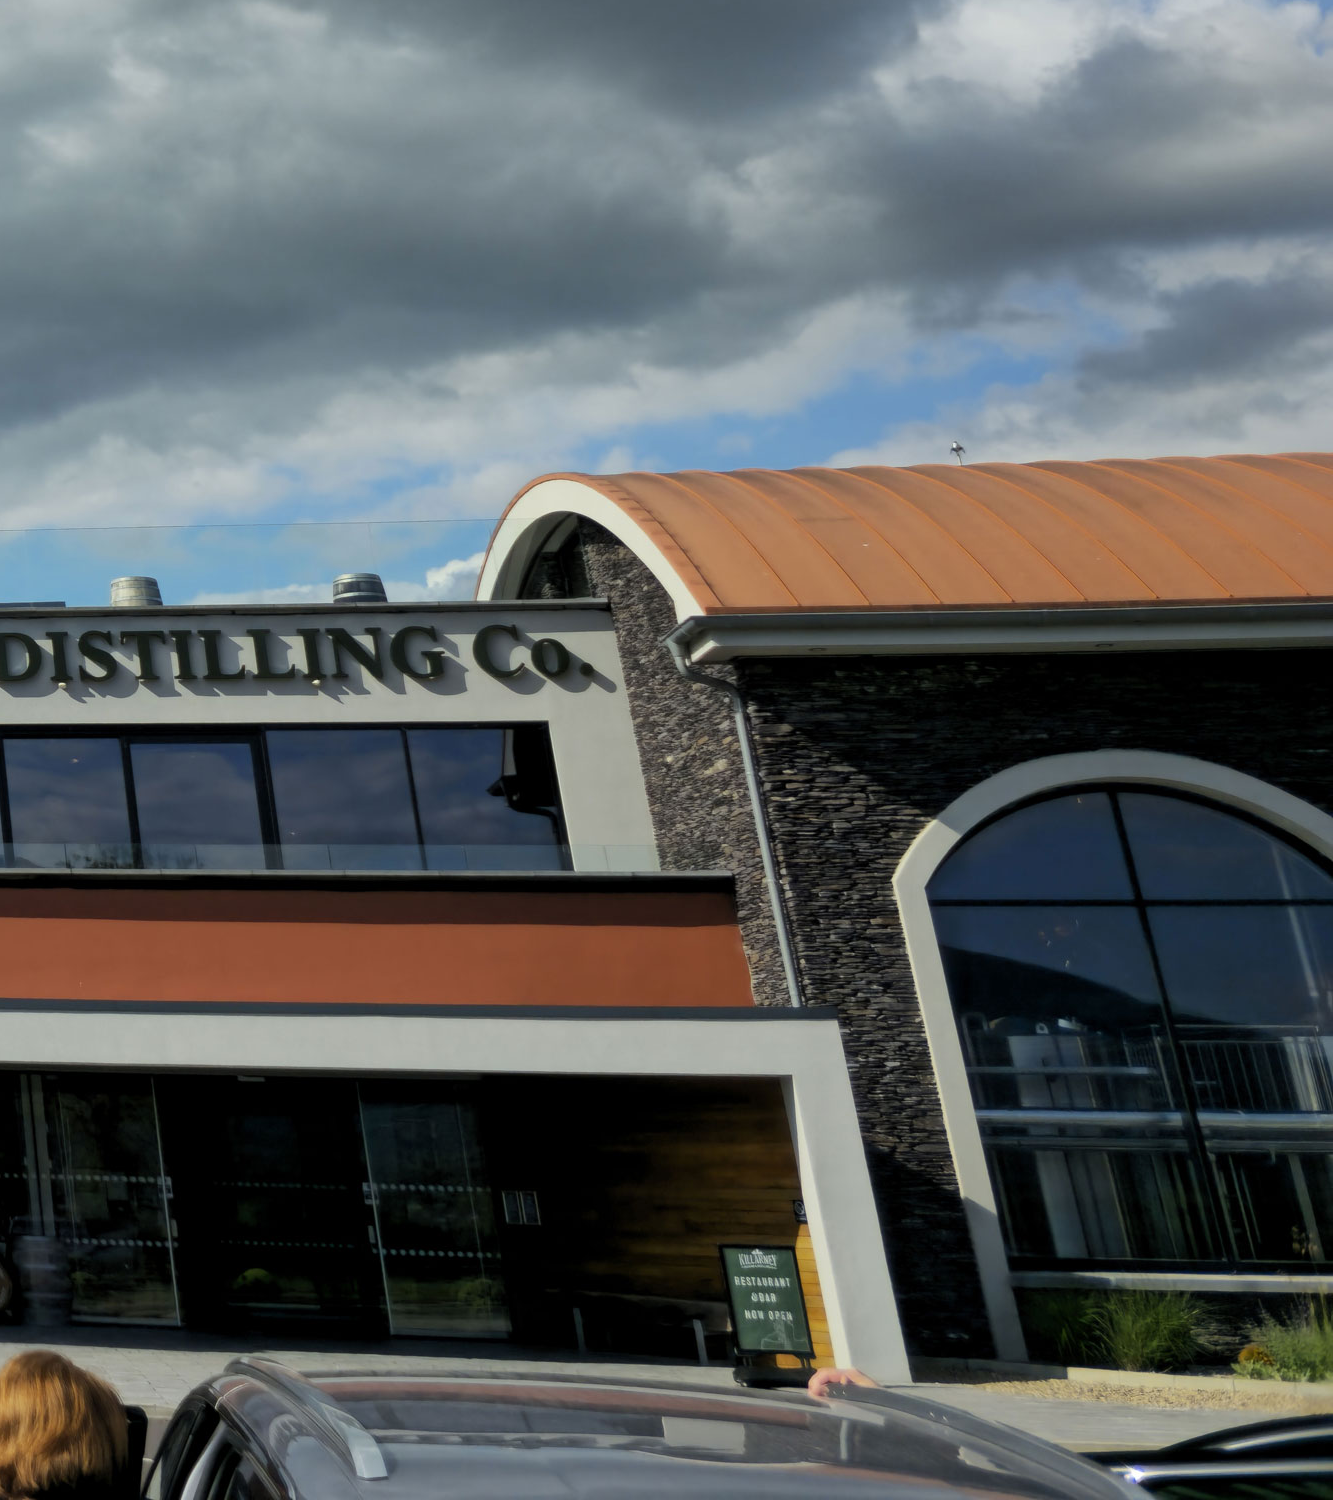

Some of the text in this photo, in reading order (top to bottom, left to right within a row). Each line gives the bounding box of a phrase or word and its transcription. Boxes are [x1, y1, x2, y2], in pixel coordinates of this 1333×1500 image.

[472, 623, 595, 678] Co.
[738, 1253, 777, 1266] KILLARNEY
[734, 1276, 790, 1287] RESTAURANT
[744, 1309, 793, 1321] NOW OPEN
